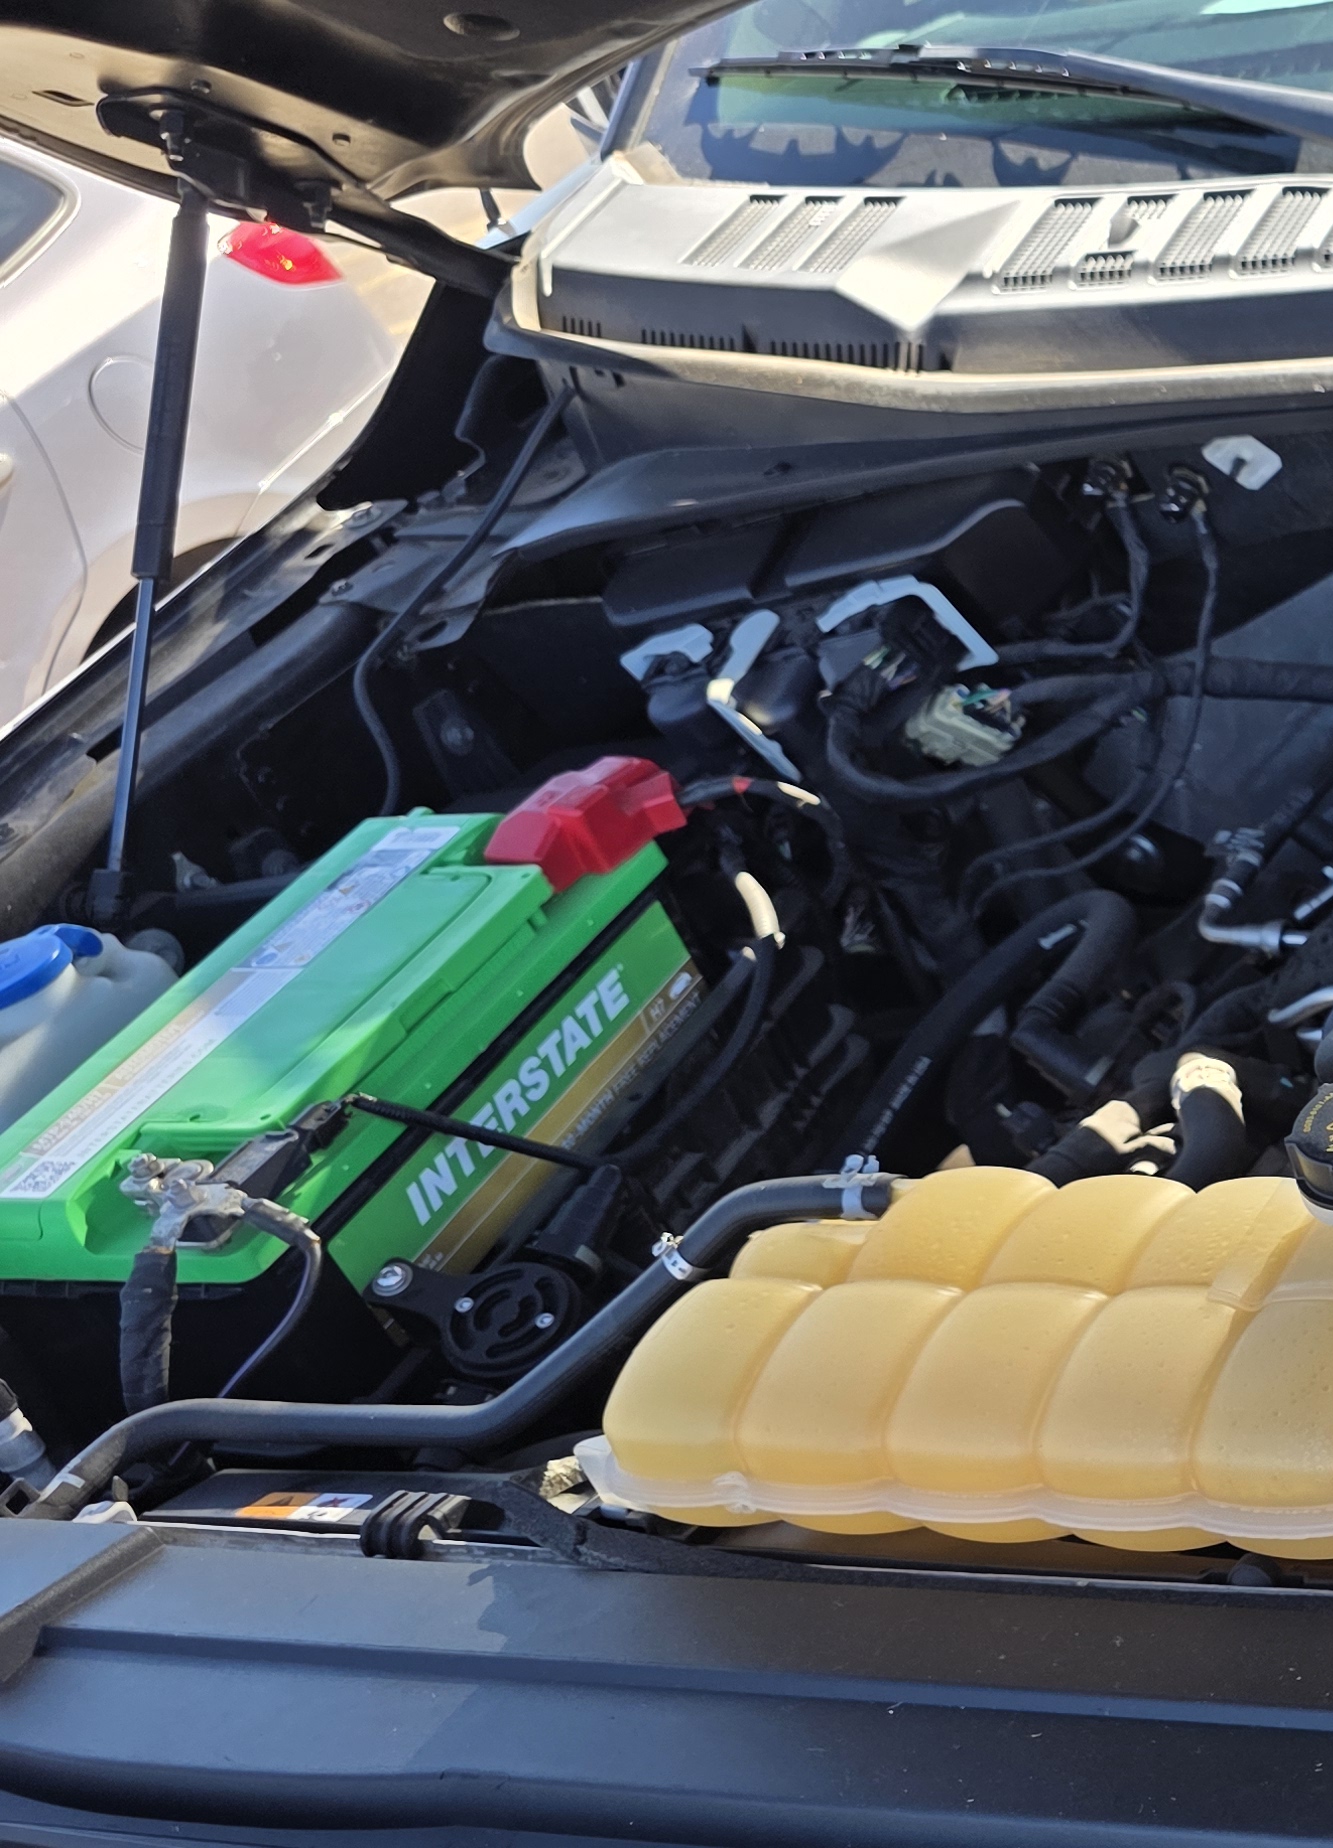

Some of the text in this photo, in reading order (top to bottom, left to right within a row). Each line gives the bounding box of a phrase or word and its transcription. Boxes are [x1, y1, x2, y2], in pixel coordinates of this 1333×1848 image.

[637, 991, 700, 1067] REPLACEMENT
[650, 998, 666, 1021] H7
[406, 968, 630, 1227] INTERSTATE
